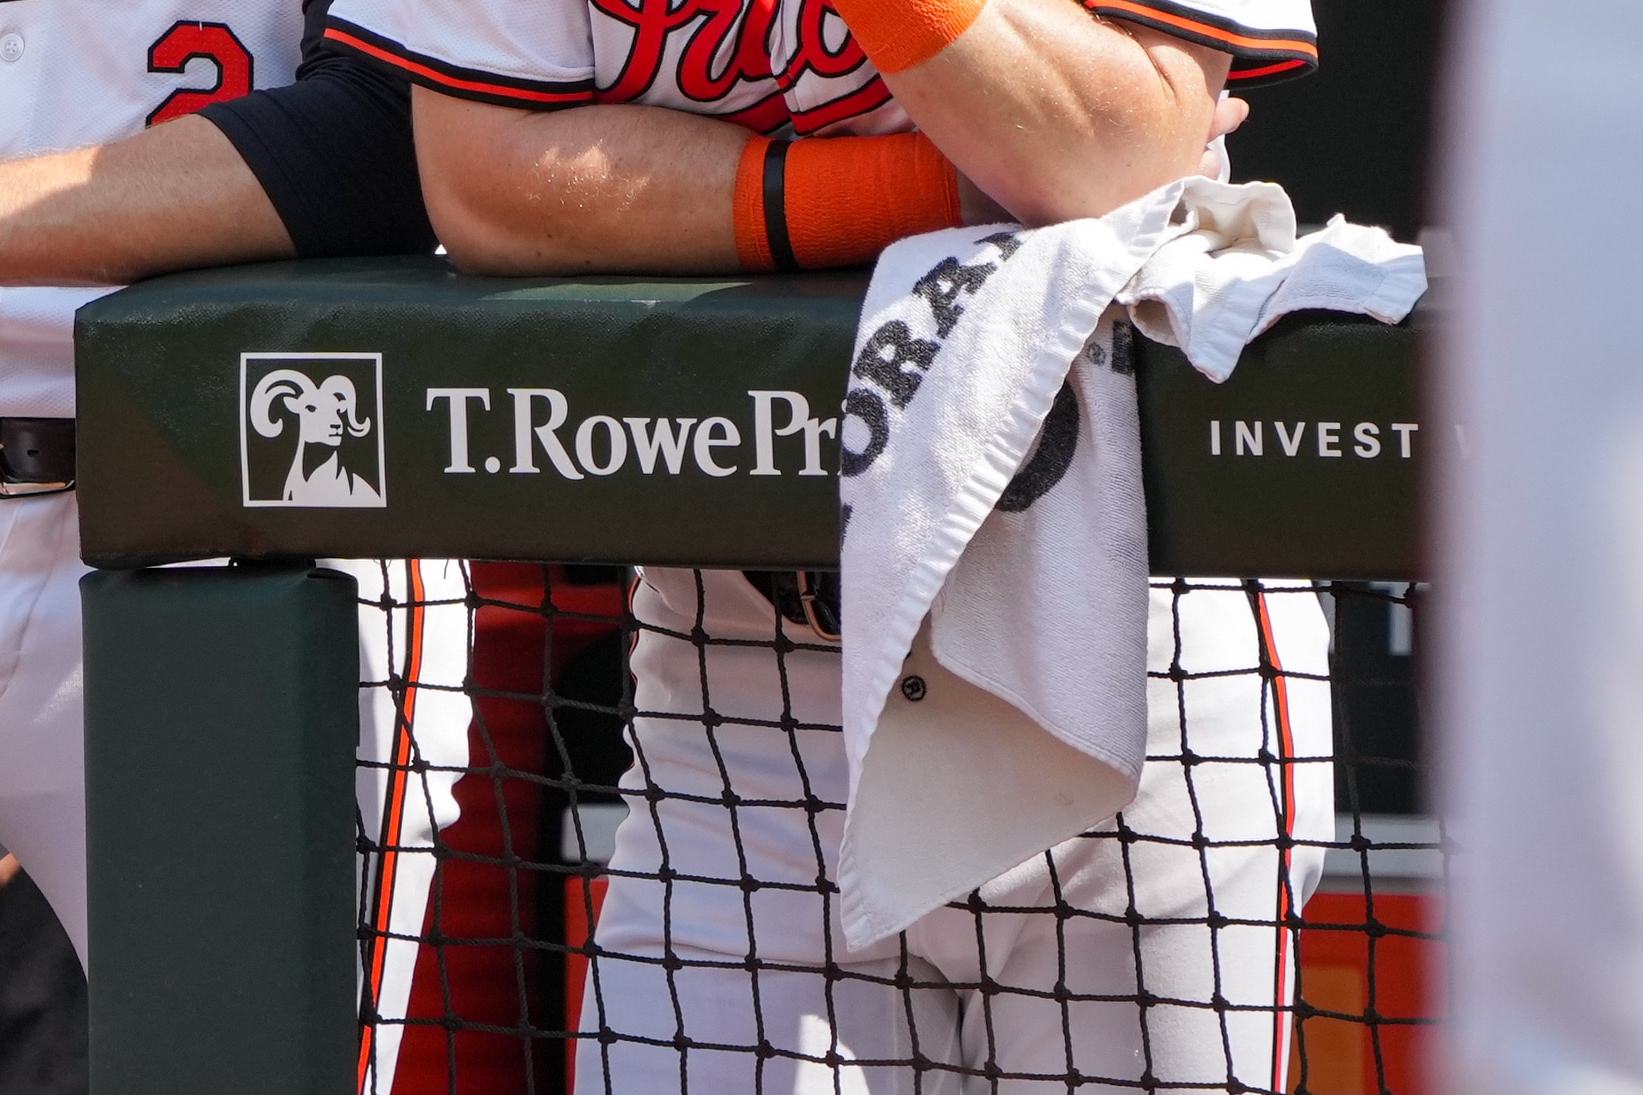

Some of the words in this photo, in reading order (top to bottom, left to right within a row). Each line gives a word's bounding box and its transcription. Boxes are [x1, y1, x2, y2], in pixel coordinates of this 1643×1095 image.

[145, 20, 254, 126] 2
[747, 390, 847, 477] Pr
[1210, 419, 1420, 460] INVEST
